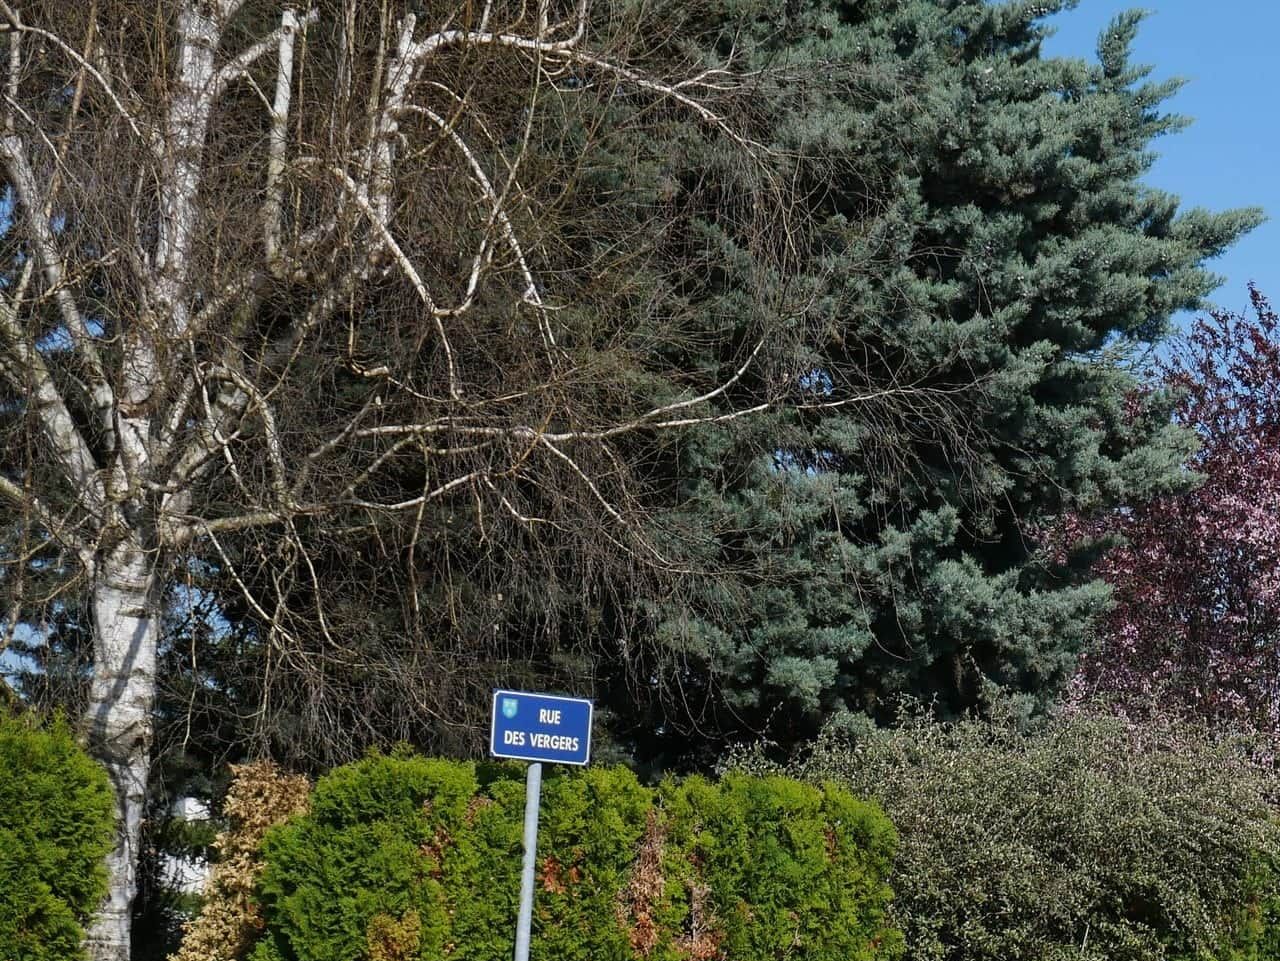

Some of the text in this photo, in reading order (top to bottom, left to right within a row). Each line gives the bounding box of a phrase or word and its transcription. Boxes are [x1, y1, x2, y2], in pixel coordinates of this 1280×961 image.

[539, 708, 561, 725] RUE
[503, 730, 579, 752] DES VERGERS
